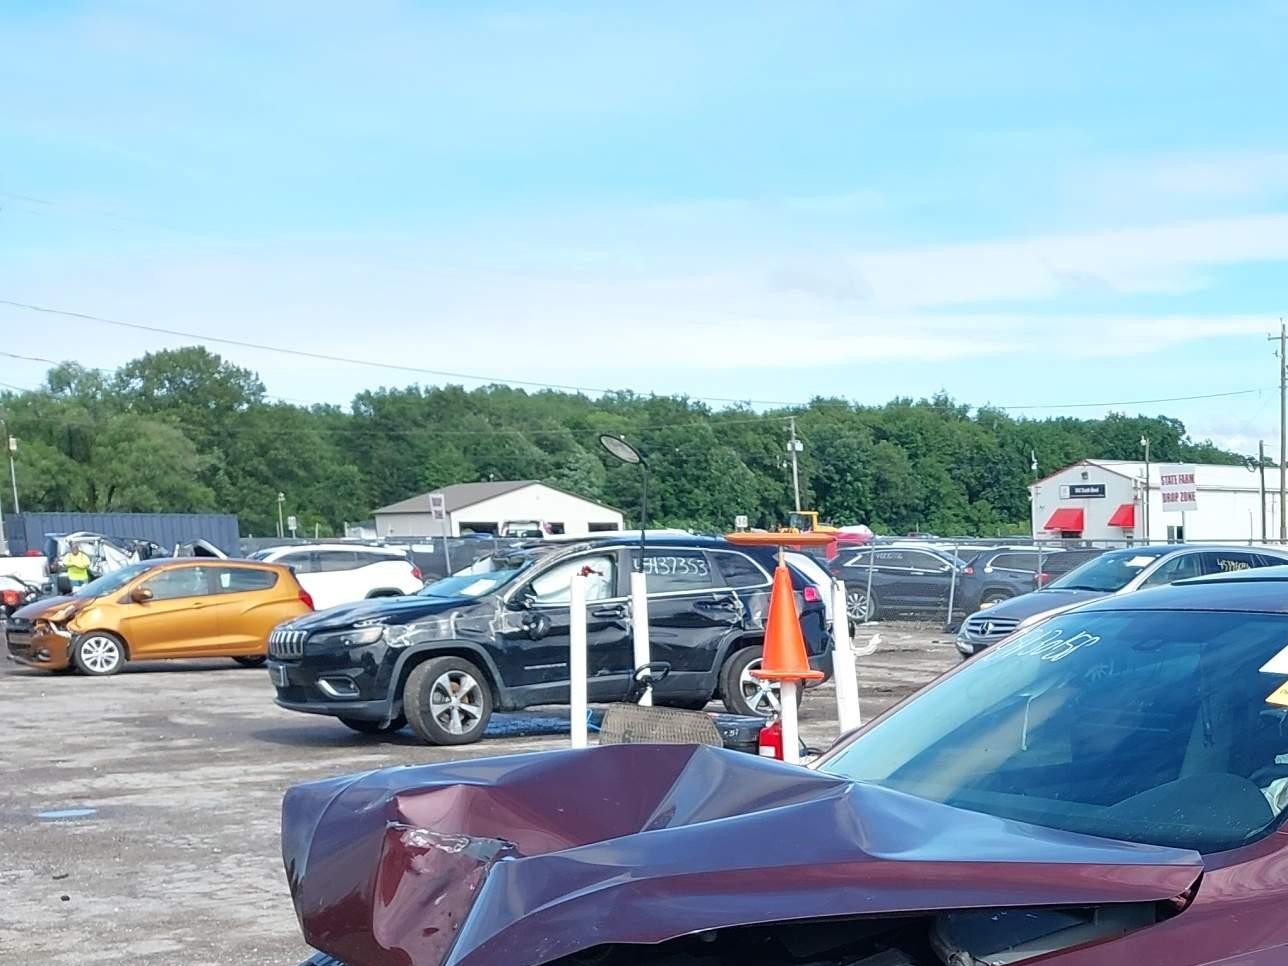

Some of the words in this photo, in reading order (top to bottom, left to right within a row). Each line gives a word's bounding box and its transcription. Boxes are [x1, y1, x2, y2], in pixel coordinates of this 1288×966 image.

[1160, 475, 1178, 486] STATE
[1178, 473, 1195, 485] FARM
[1162, 492, 1179, 503] DROP
[1180, 491, 1196, 503] ZONE
